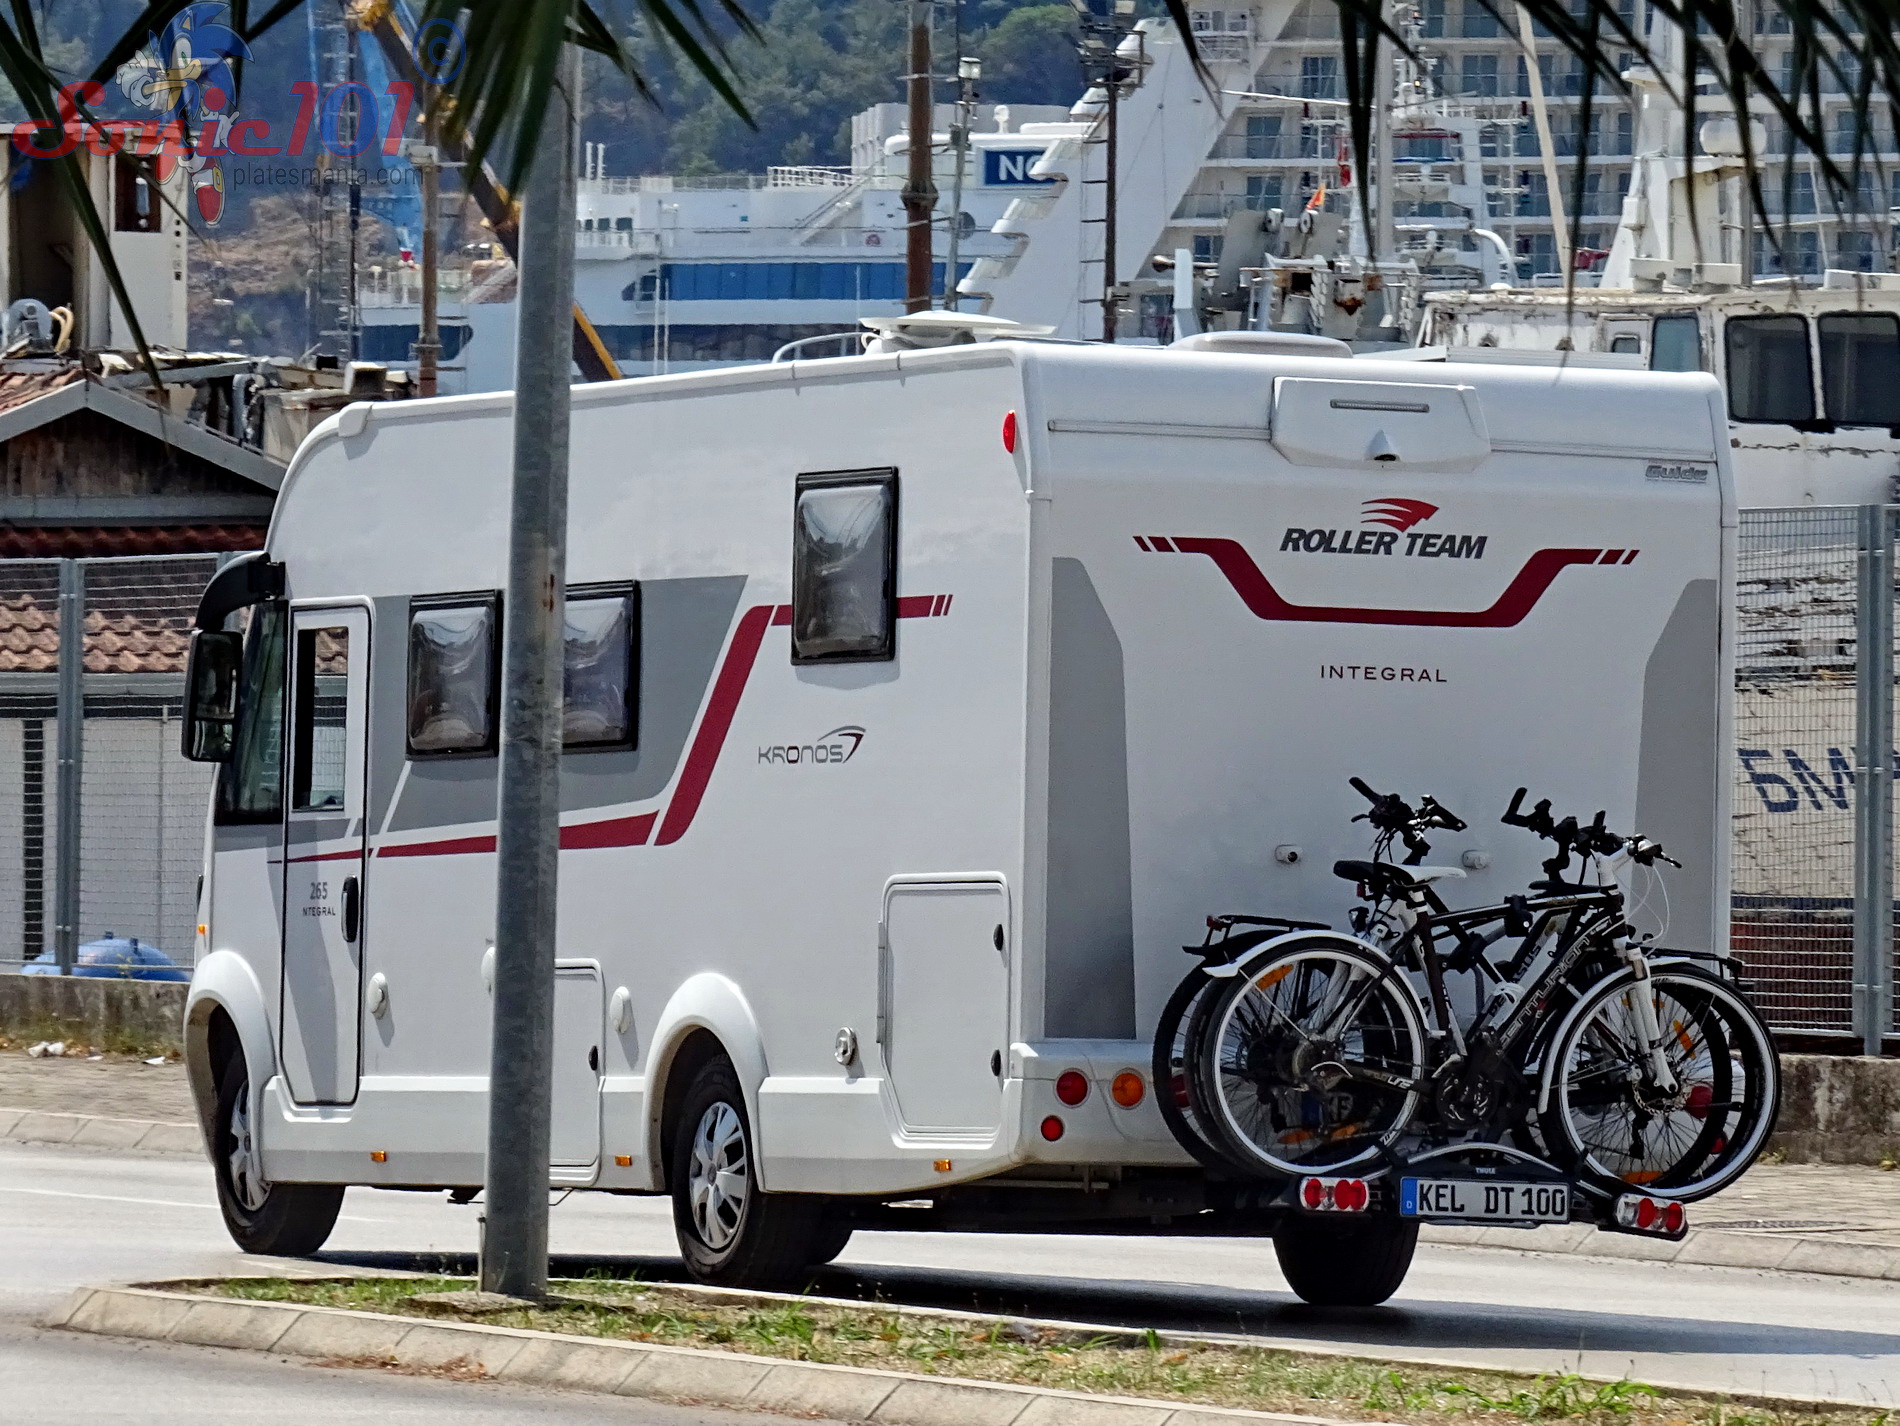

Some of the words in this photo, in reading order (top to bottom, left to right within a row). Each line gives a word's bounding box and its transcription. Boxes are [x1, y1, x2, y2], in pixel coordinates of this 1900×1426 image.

[1280, 527, 1399, 556] ROLLER
[1404, 532, 1488, 559] TEAM
[1320, 665, 1448, 682] INTEGRAL
[310, 882, 328, 900] 265
[1418, 1183, 1465, 1213] KEL
[1484, 1186, 1514, 1215] DT
[1521, 1188, 1566, 1216] 100
